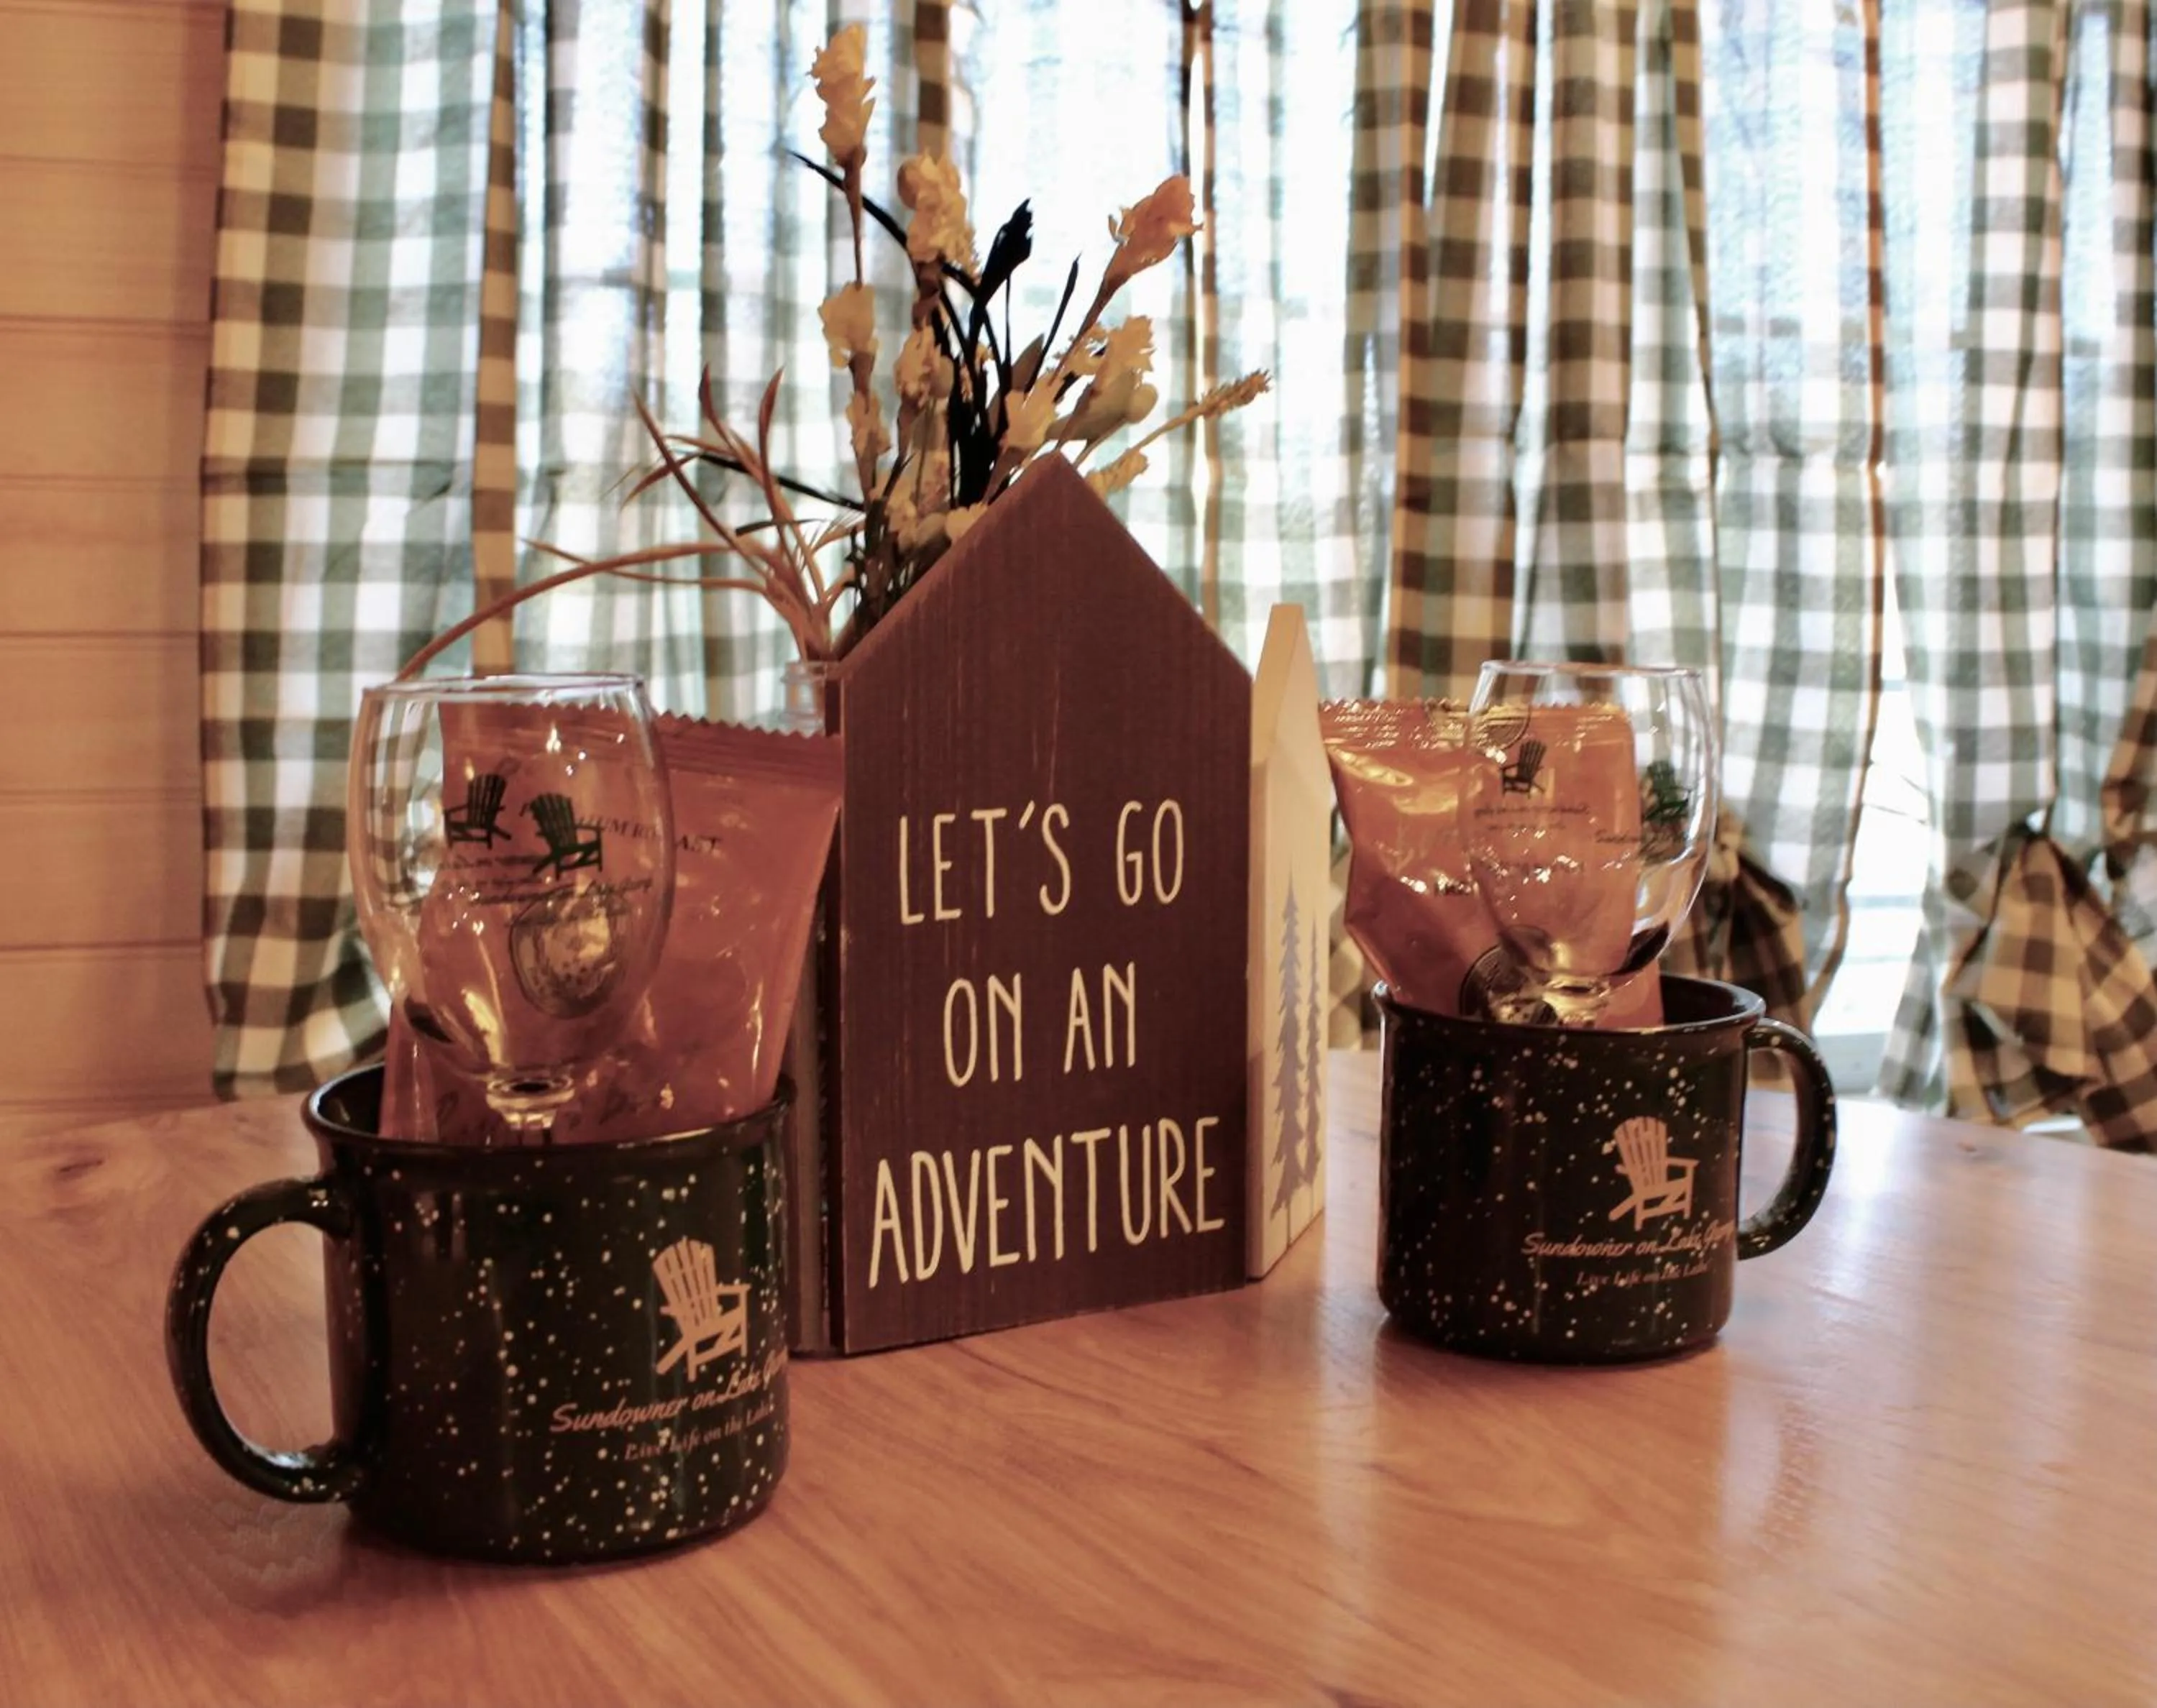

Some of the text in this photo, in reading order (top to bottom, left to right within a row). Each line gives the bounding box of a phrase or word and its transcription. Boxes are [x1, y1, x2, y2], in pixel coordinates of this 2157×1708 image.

[899, 798, 1184, 926] LET'S GO
[943, 960, 1136, 1088] ON AN
[868, 1116, 1226, 1290] ADVENTURE
[1521, 1231, 1634, 1258] Sundowner
[1635, 1239, 1657, 1256] on
[550, 1397, 687, 1433] Sundowner
[692, 1390, 716, 1411] on
